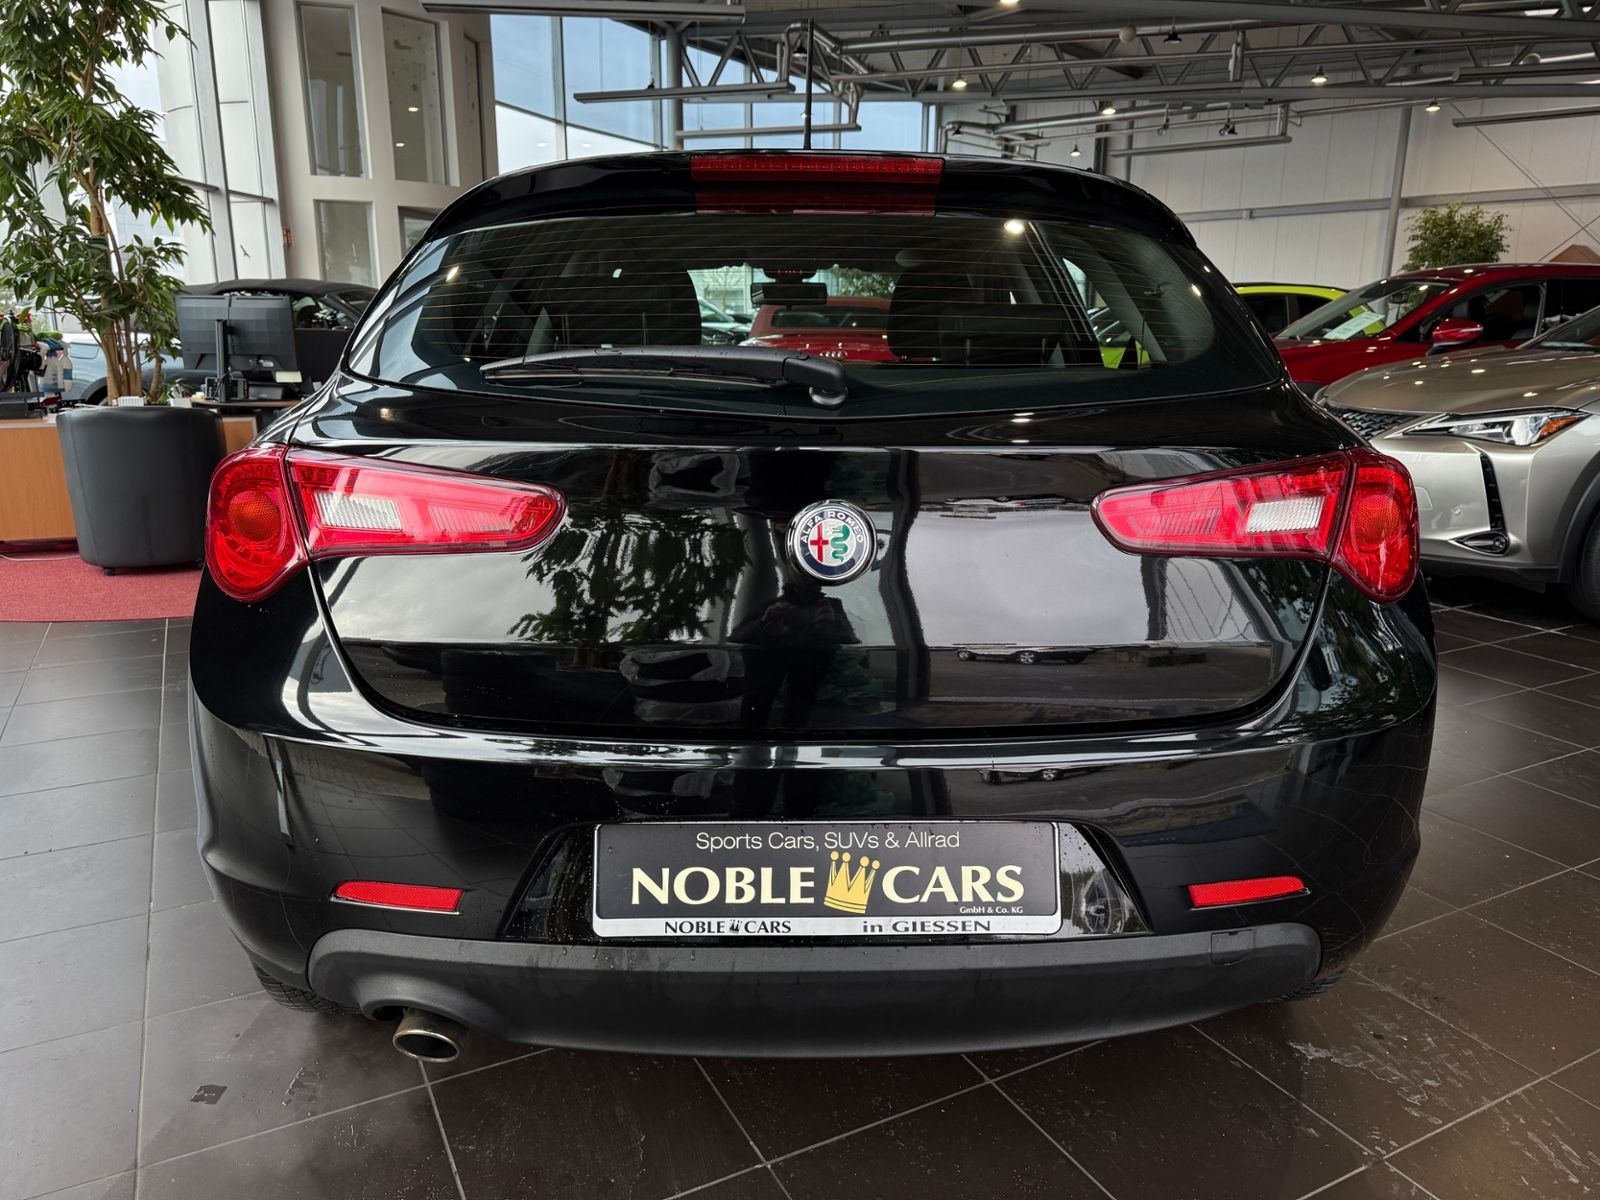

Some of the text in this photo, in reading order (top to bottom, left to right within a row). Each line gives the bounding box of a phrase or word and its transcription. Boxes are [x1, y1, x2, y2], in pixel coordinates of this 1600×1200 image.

[800, 511, 864, 543] ALFA ROMEO
[696, 831, 960, 852] Sports Cars, SUVs & Allrad
[631, 865, 1025, 905] NOBLE CARS
[959, 906, 1023, 914] GmbH & Co. KG
[664, 920, 991, 934] NOBLE CARS in GIESSEN
